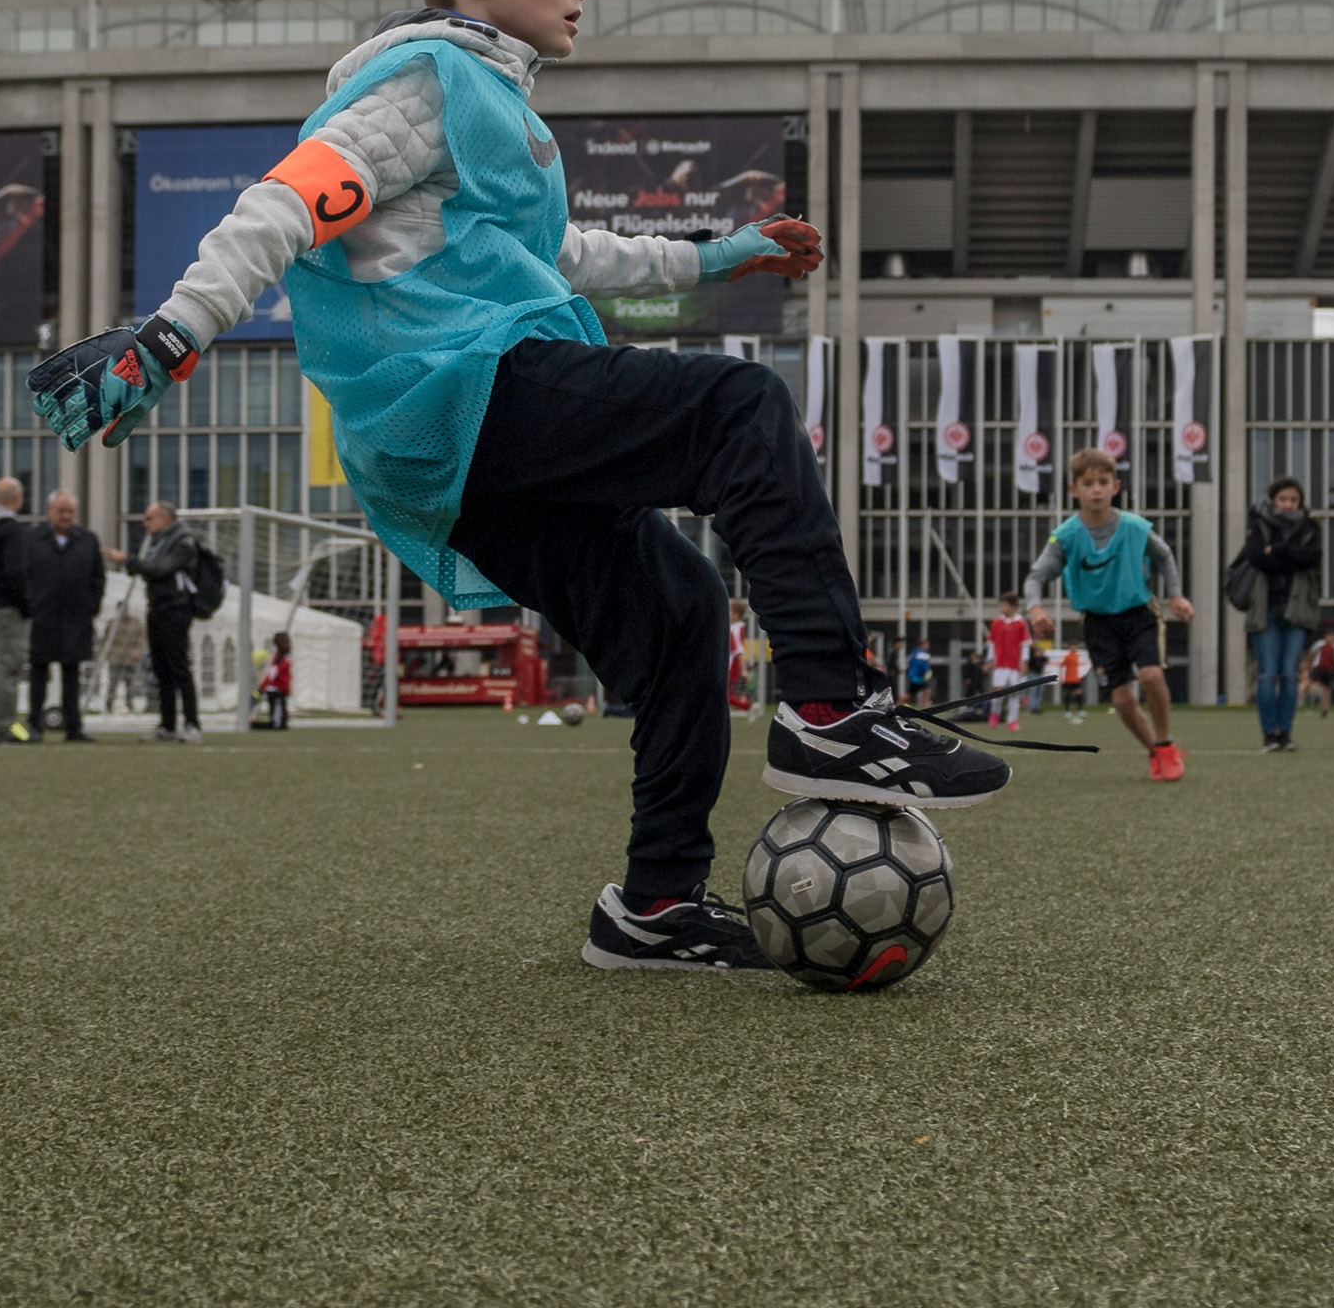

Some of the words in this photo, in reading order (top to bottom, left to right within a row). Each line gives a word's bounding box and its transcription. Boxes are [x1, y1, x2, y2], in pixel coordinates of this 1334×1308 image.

[315, 180, 366, 223] C
[574, 189, 628, 208] Neue
[633, 189, 681, 207] Jobs
[685, 191, 719, 206] nur
[612, 213, 734, 237] Flügelschlag
[158, 331, 183, 359] MANUEL
[167, 331, 188, 356] NEUER
[125, 349, 145, 387] adidas
[874, 725, 900, 744] Reebok
